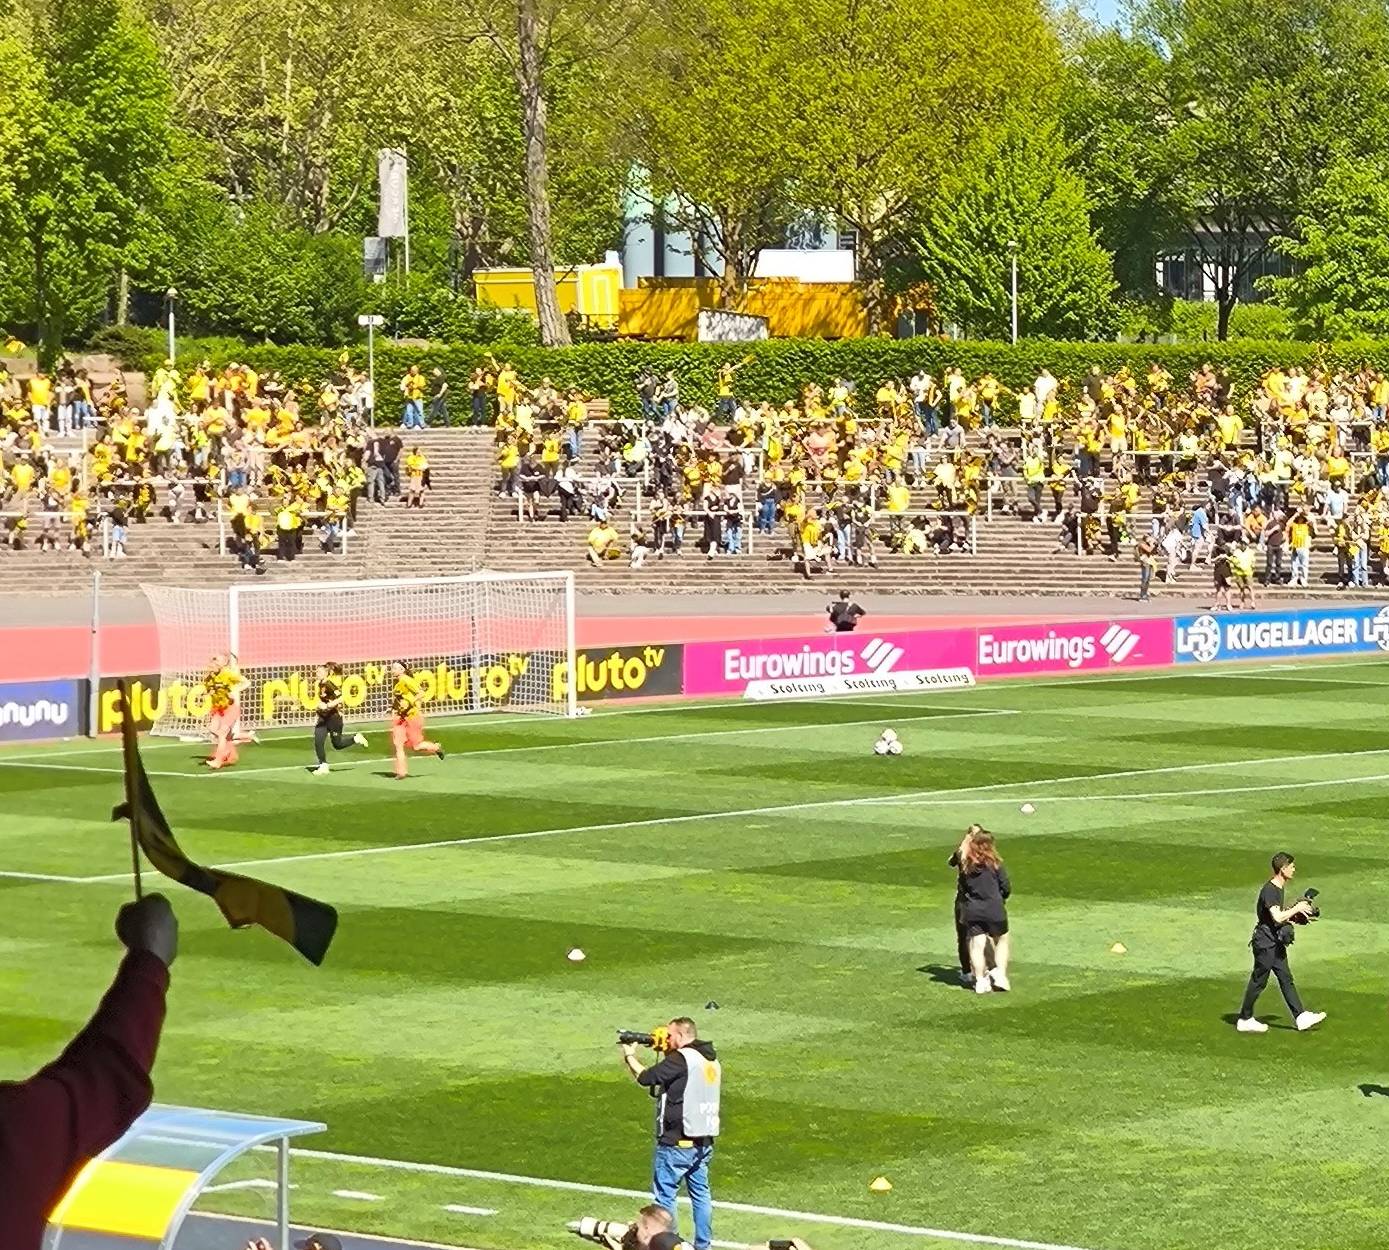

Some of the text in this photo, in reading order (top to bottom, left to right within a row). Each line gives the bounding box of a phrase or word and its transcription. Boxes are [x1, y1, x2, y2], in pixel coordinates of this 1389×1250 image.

[978, 631, 1096, 668] Eurowings
[1227, 617, 1357, 650] KUGELLAGER
[507, 654, 529, 676] tv
[553, 646, 665, 700] pluto tv
[724, 646, 855, 680] Eurowings
[0, 699, 68, 727] nunu
[101, 680, 212, 733] pluto
